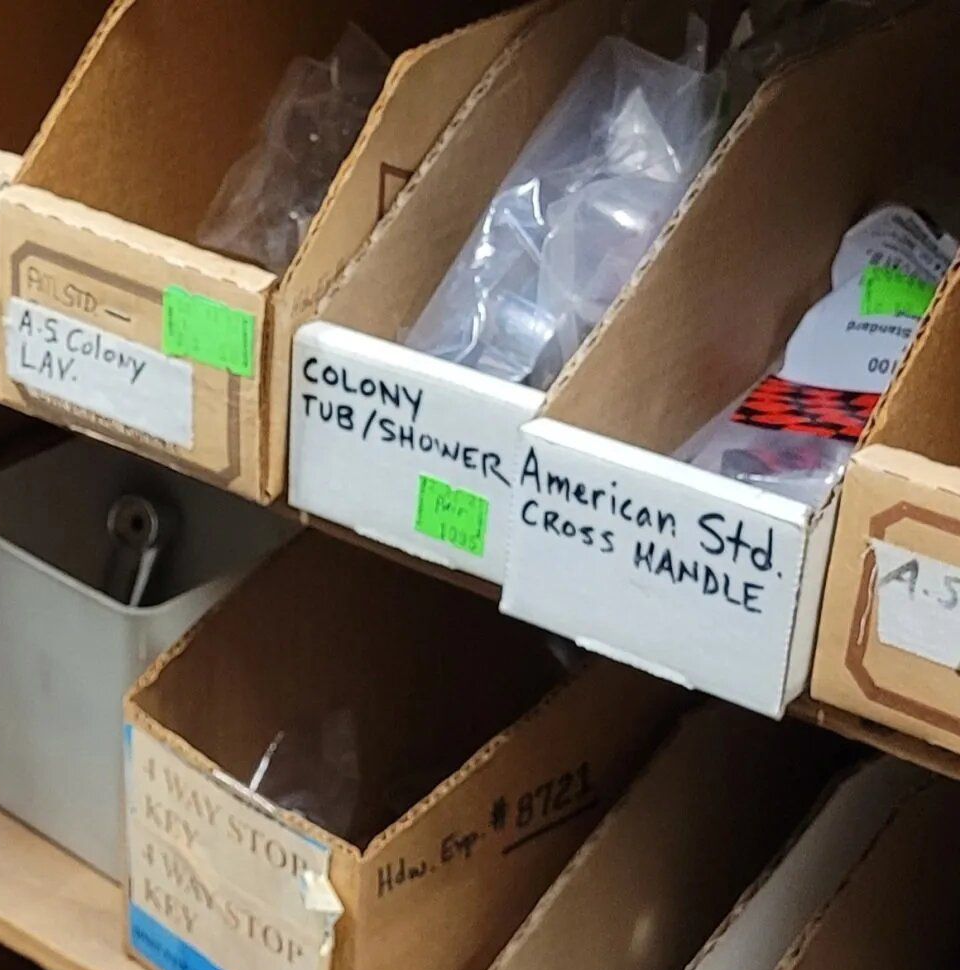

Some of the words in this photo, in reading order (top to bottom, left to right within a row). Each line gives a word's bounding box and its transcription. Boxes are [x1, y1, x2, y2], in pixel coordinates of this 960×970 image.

[20, 342, 77, 382] LAV.
[302, 357, 424, 423] COLONY
[302, 394, 512, 488] TUB/SHOWER
[520, 446, 676, 537] American
[697, 512, 783, 580] Std.
[521, 499, 615, 553] CROSS
[633, 541, 765, 615] HANDLE
[144, 796, 200, 851] KEY
[163, 767, 221, 828] WAY
[144, 878, 197, 935] KEY
[161, 853, 214, 909] WAY
[225, 899, 304, 963] STOP
